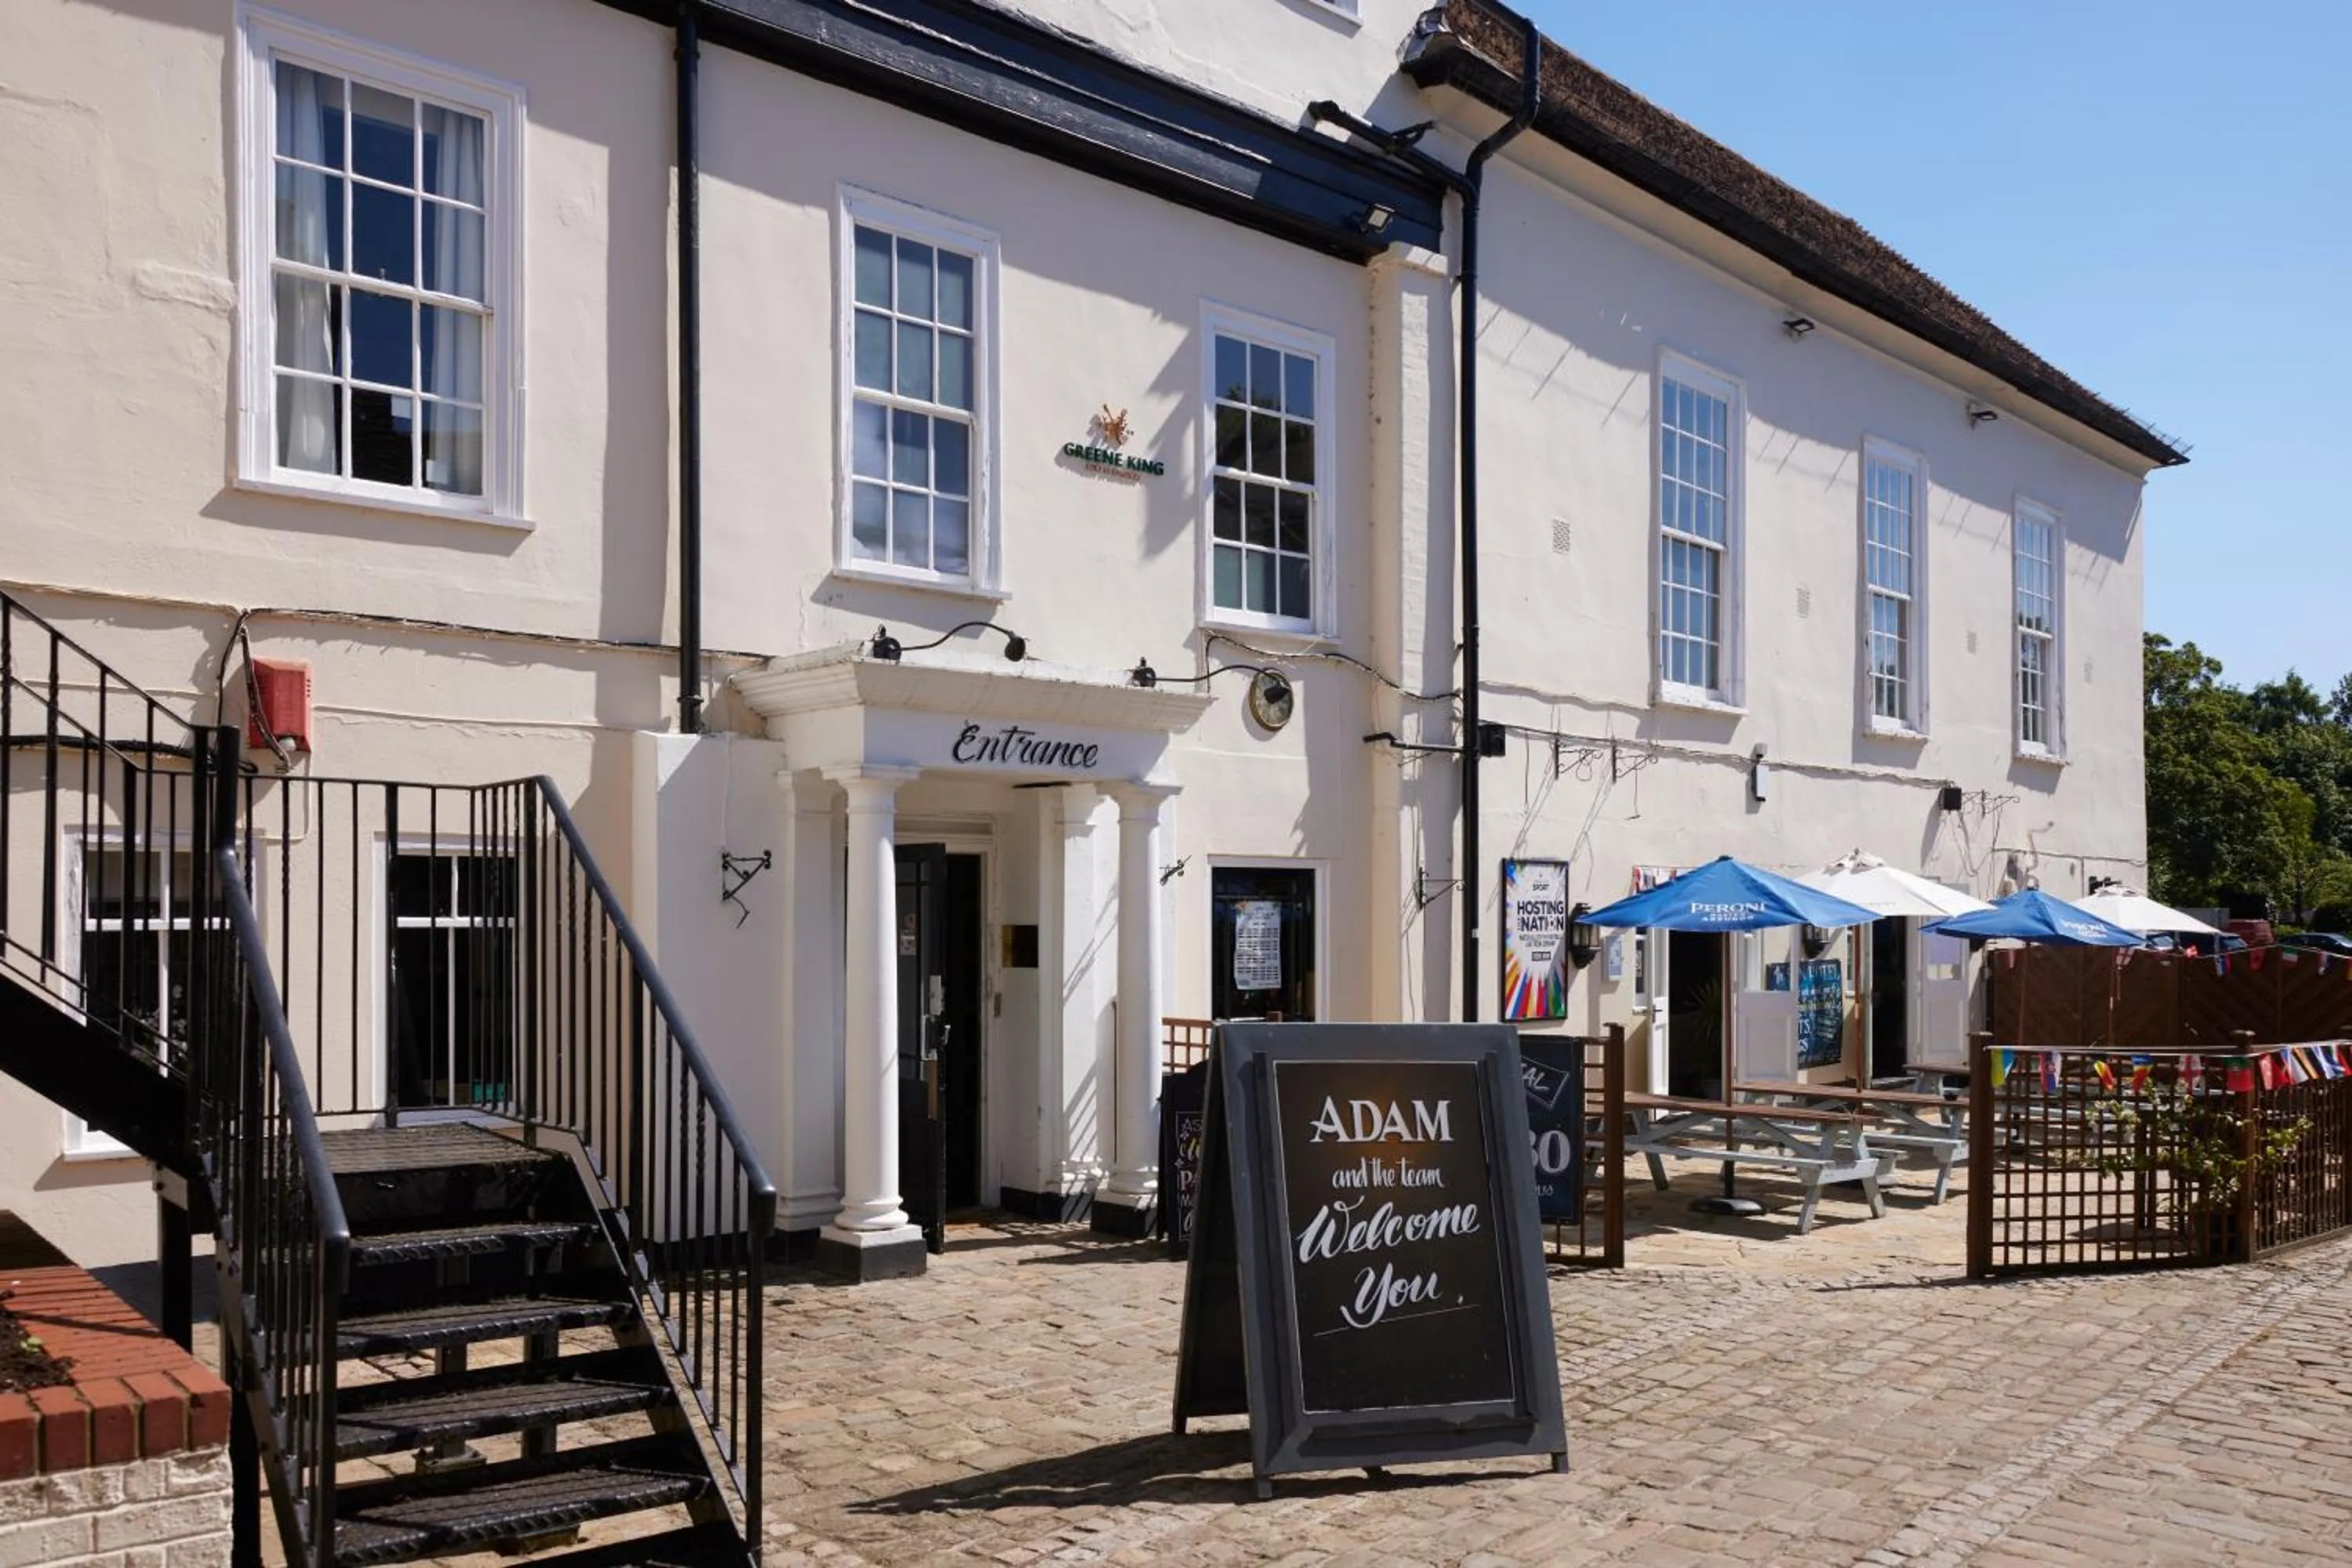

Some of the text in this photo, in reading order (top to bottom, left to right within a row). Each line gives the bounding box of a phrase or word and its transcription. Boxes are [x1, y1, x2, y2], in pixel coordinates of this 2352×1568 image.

[1063, 441, 1123, 466] GREENE
[1127, 456, 1164, 476] KING
[952, 722, 1099, 768] Entrance
[1517, 900, 1564, 915] HOSTING
[1690, 902, 1766, 914] PERONI
[1308, 1094, 1455, 1142] ADAM
[1332, 1156, 1445, 1189] and the team
[1295, 1195, 1481, 1264] Welcome
[1340, 1261, 1443, 1328] You
